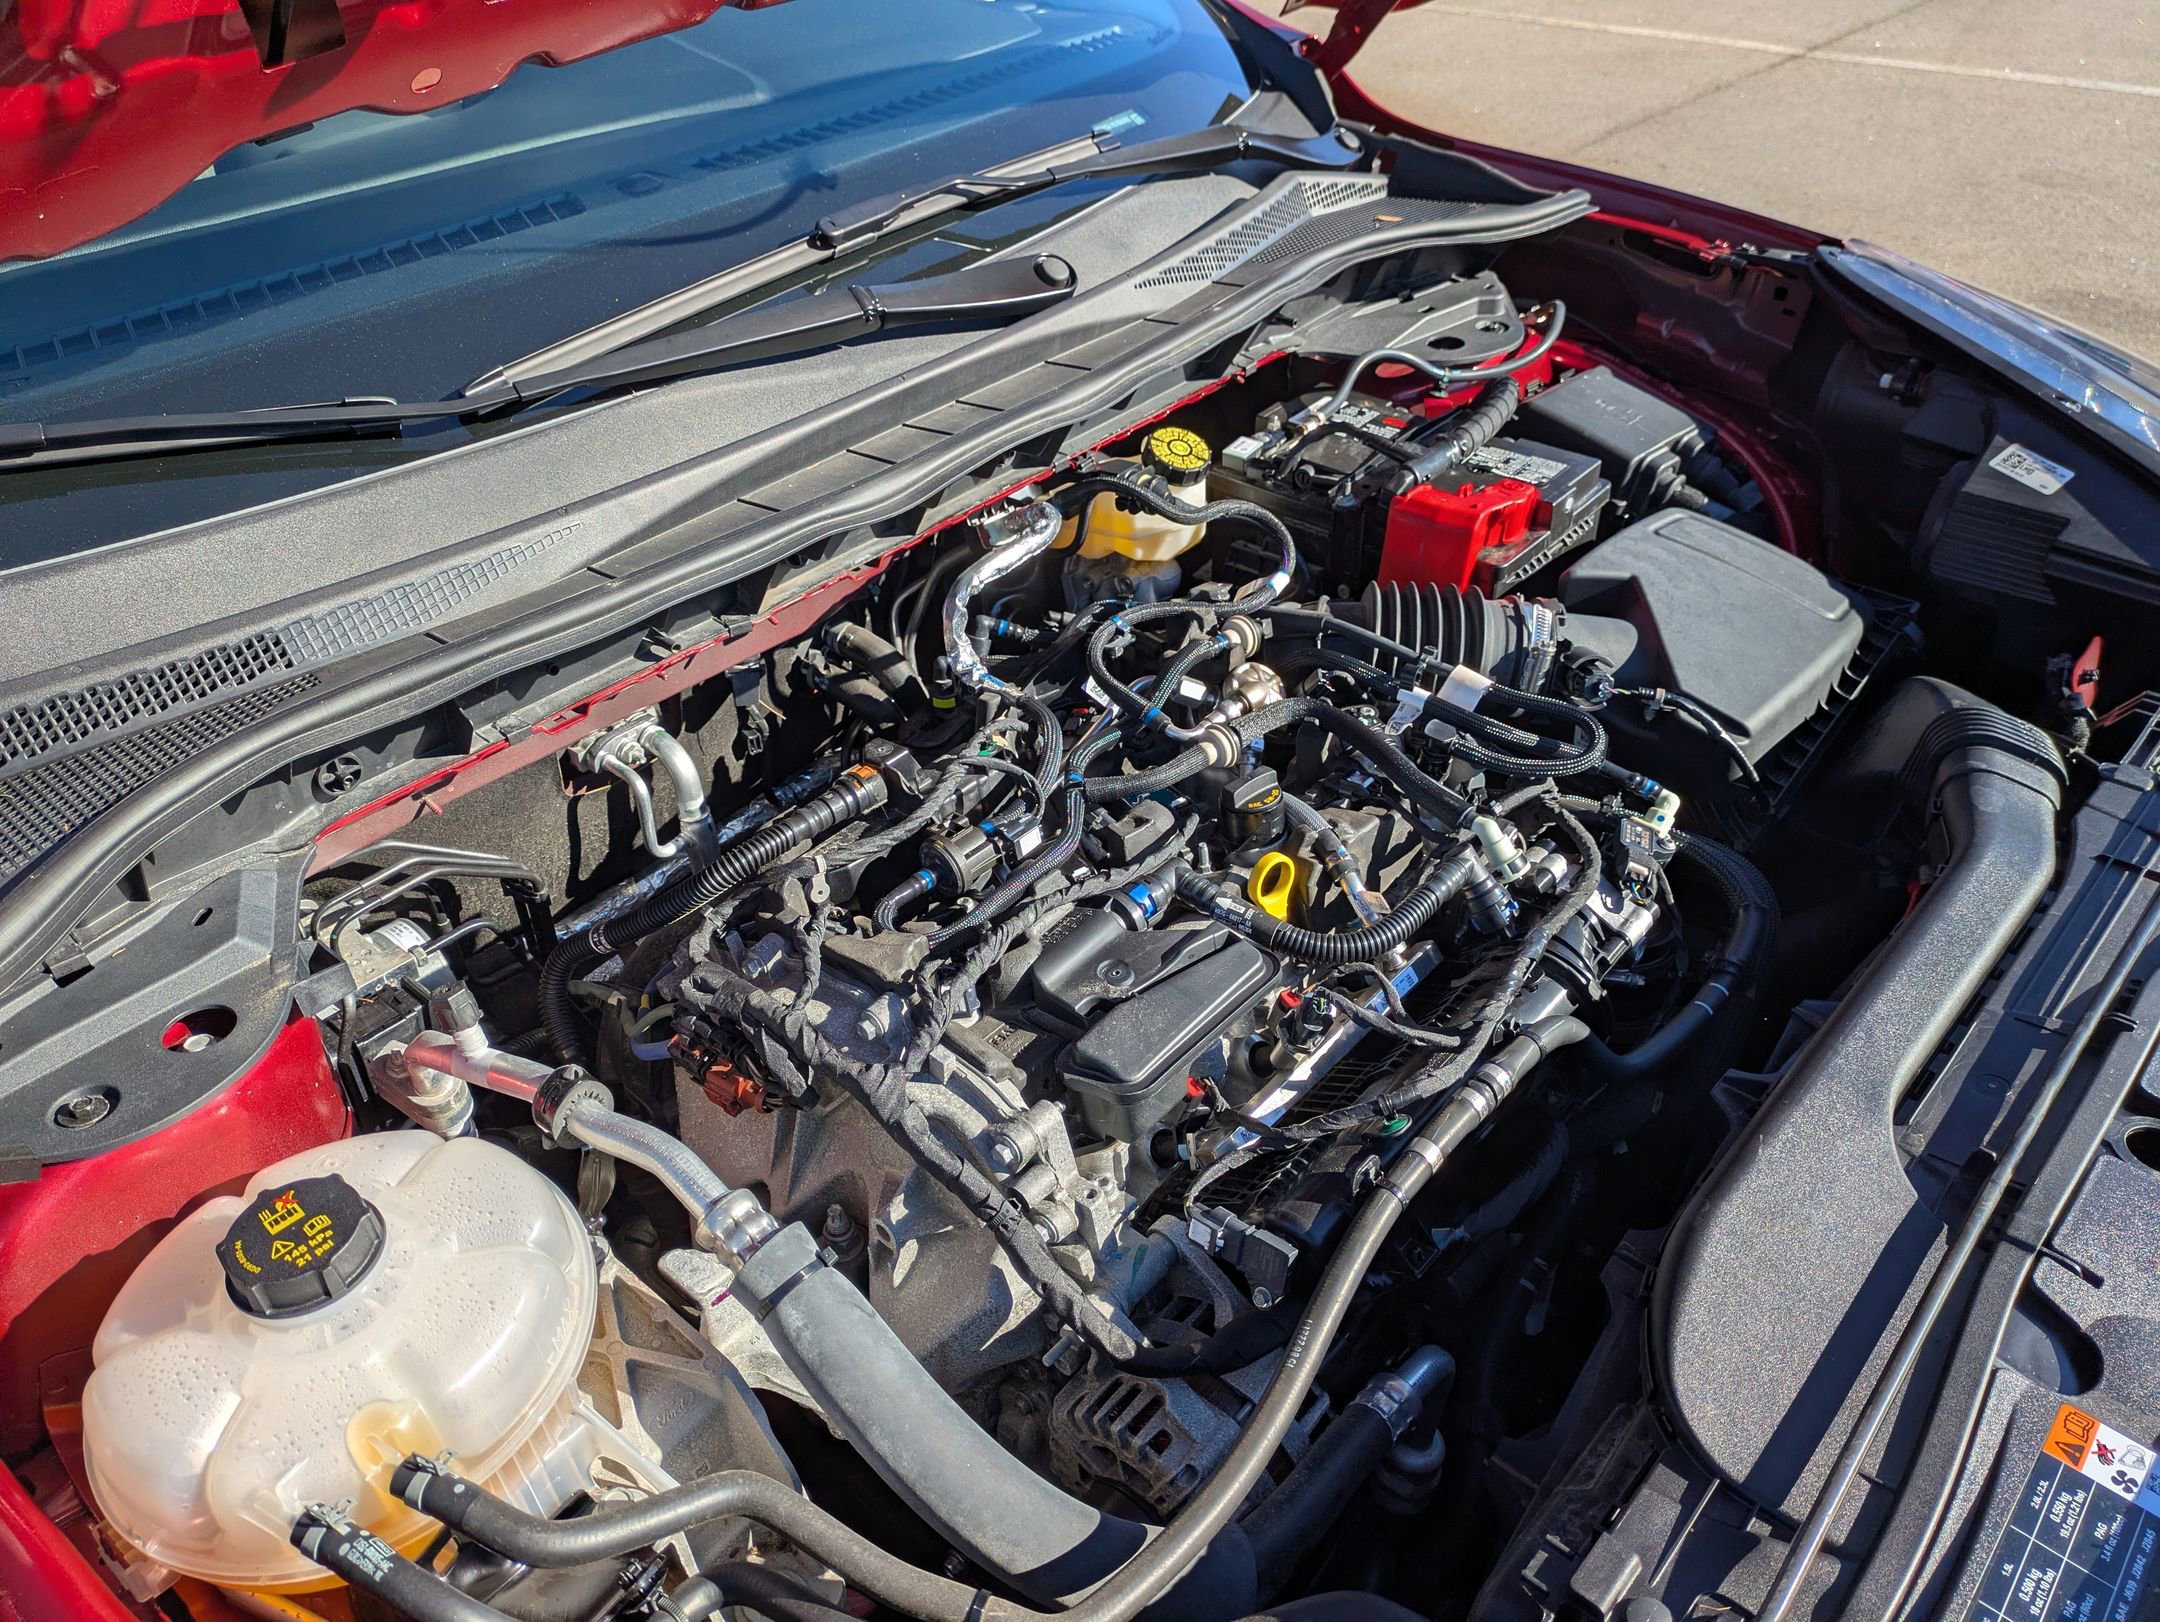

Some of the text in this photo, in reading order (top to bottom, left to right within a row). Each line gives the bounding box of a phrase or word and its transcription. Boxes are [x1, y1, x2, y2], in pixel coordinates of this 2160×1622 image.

[284, 1229, 334, 1262] 145 kPa
[296, 1239, 334, 1267] 21 psi
[2049, 1491, 2072, 1522] 0.550 kg
[2059, 1523, 2072, 1539] 19.5
[2066, 1516, 2075, 1526] oz
[2094, 1522, 2107, 1539] PAG
[2109, 1537, 2117, 1547] oz
[2001, 1563, 2014, 1576] 1.5L
[2018, 1568, 2043, 1601] 0.500 kg
[2029, 1605, 2040, 1616] 18
[2034, 1597, 2044, 1608] oz
[2063, 1599, 2076, 1618] PAG
